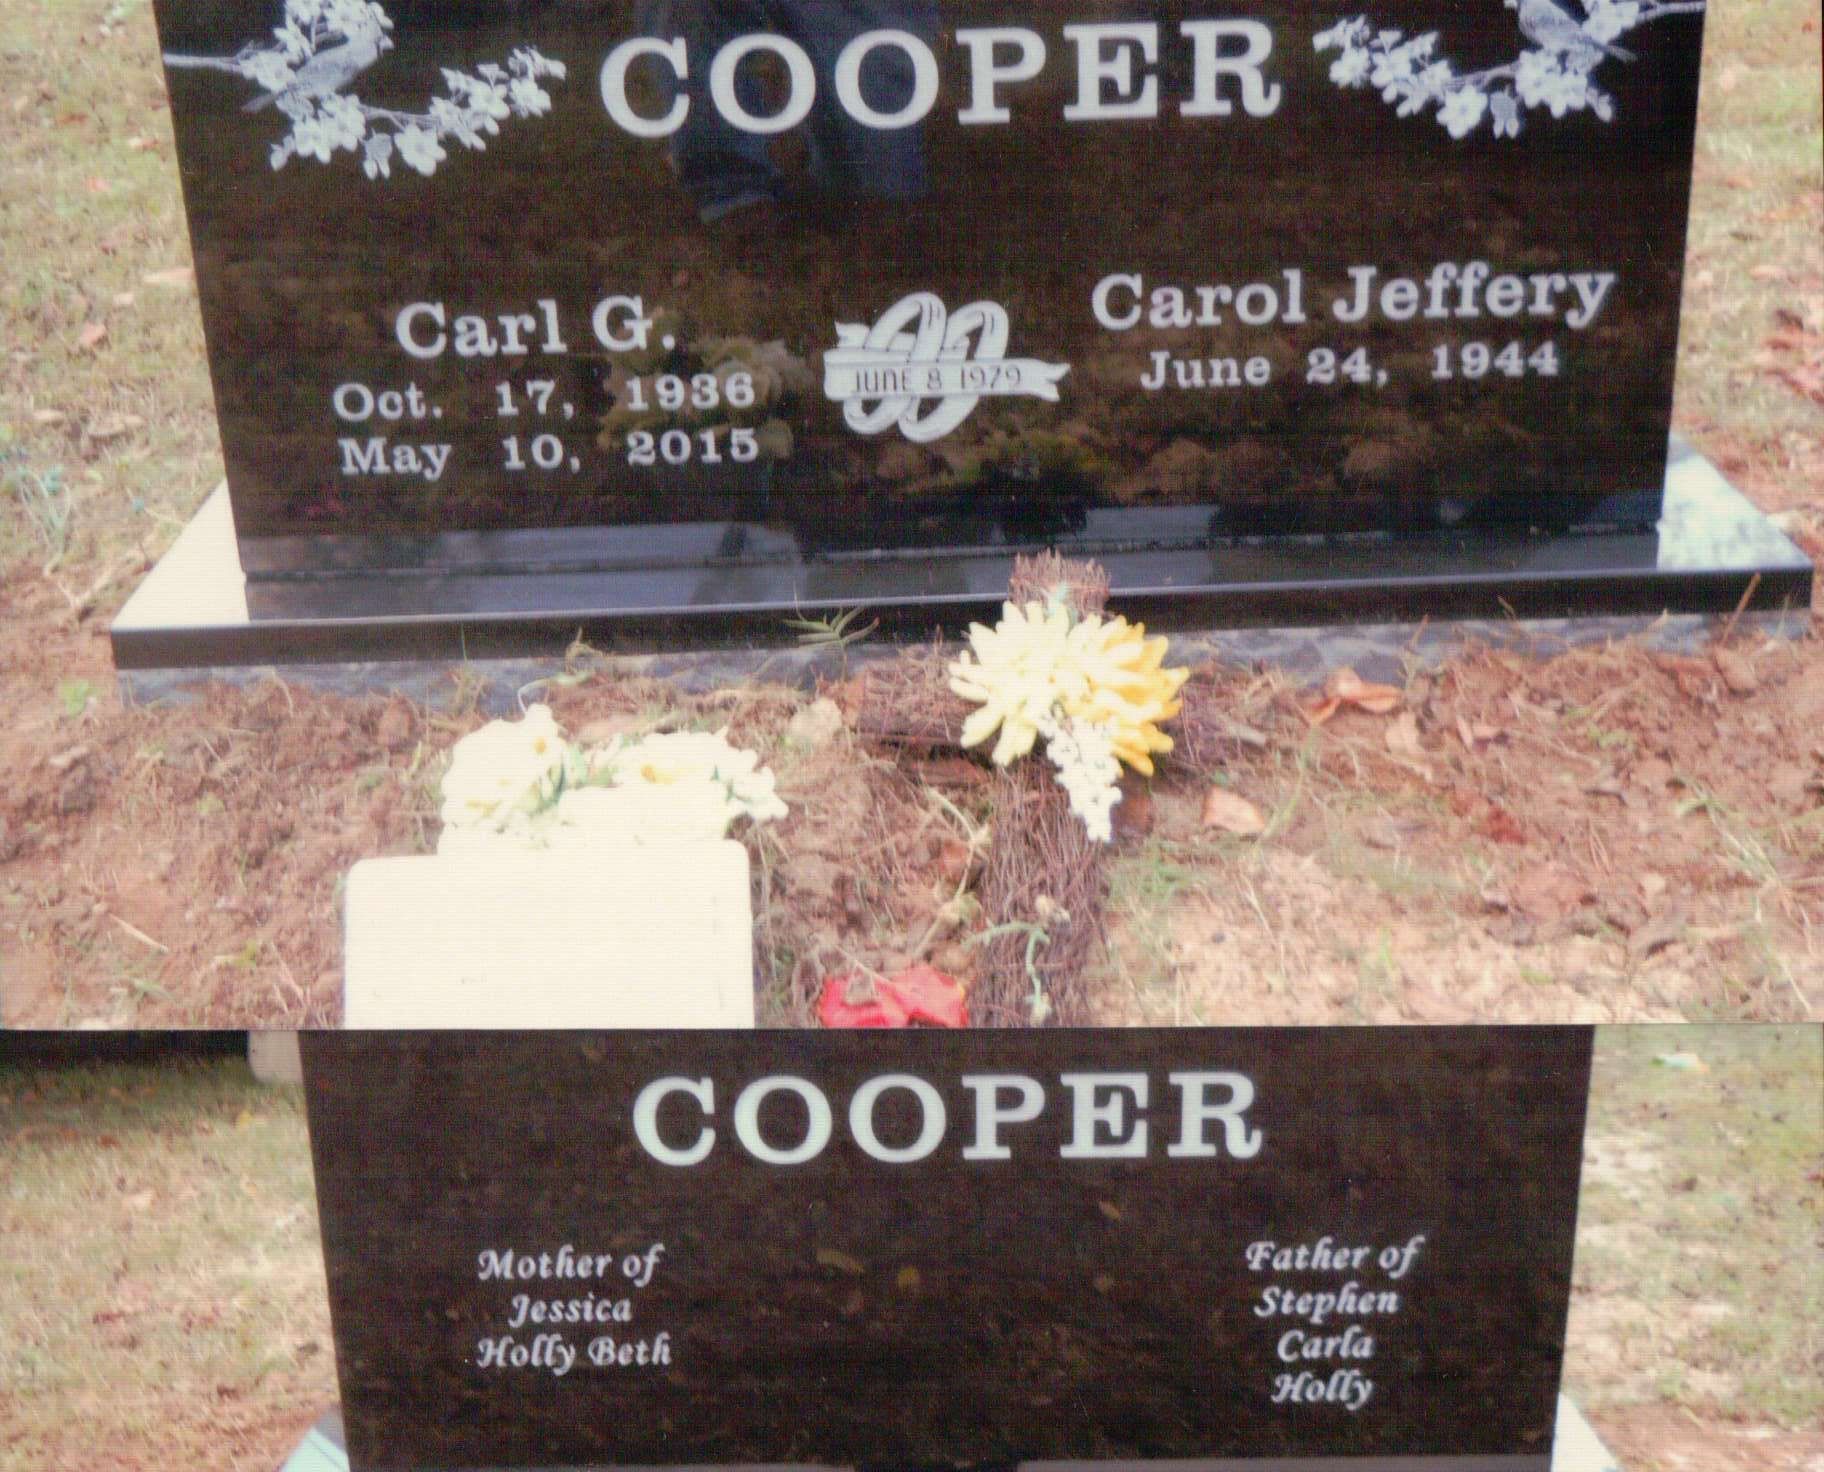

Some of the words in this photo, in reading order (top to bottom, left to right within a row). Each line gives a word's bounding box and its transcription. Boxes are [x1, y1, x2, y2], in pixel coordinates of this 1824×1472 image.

[600, 18, 1281, 137] COOPER
[1092, 268, 1307, 330] Carol
[1332, 260, 1616, 327] Jeffery
[395, 296, 568, 358] Carl
[592, 294, 676, 352] G.
[853, 366, 912, 394] JUNE
[925, 366, 943, 390] 8
[960, 366, 1022, 389] 1979
[1140, 350, 1272, 390] June
[1306, 347, 1388, 387] 24,
[1433, 342, 1558, 379] 1944
[333, 382, 443, 421] Oct.
[495, 380, 574, 417] 17,
[626, 370, 757, 412] 1936
[338, 436, 451, 480] May
[502, 433, 581, 473] 10,
[626, 428, 759, 464] 2015
[633, 1071, 1263, 1167] COOPER
[478, 1243, 612, 1280] Mother
[622, 1242, 666, 1288] of
[1246, 1236, 1371, 1271] Father
[1379, 1235, 1426, 1280] of
[507, 1291, 633, 1328] Jessica
[1253, 1280, 1399, 1324] Stephen
[476, 1332, 577, 1377] Holly
[587, 1331, 672, 1367] Beth
[1276, 1324, 1374, 1363] Carla
[1270, 1368, 1374, 1411] Holly
